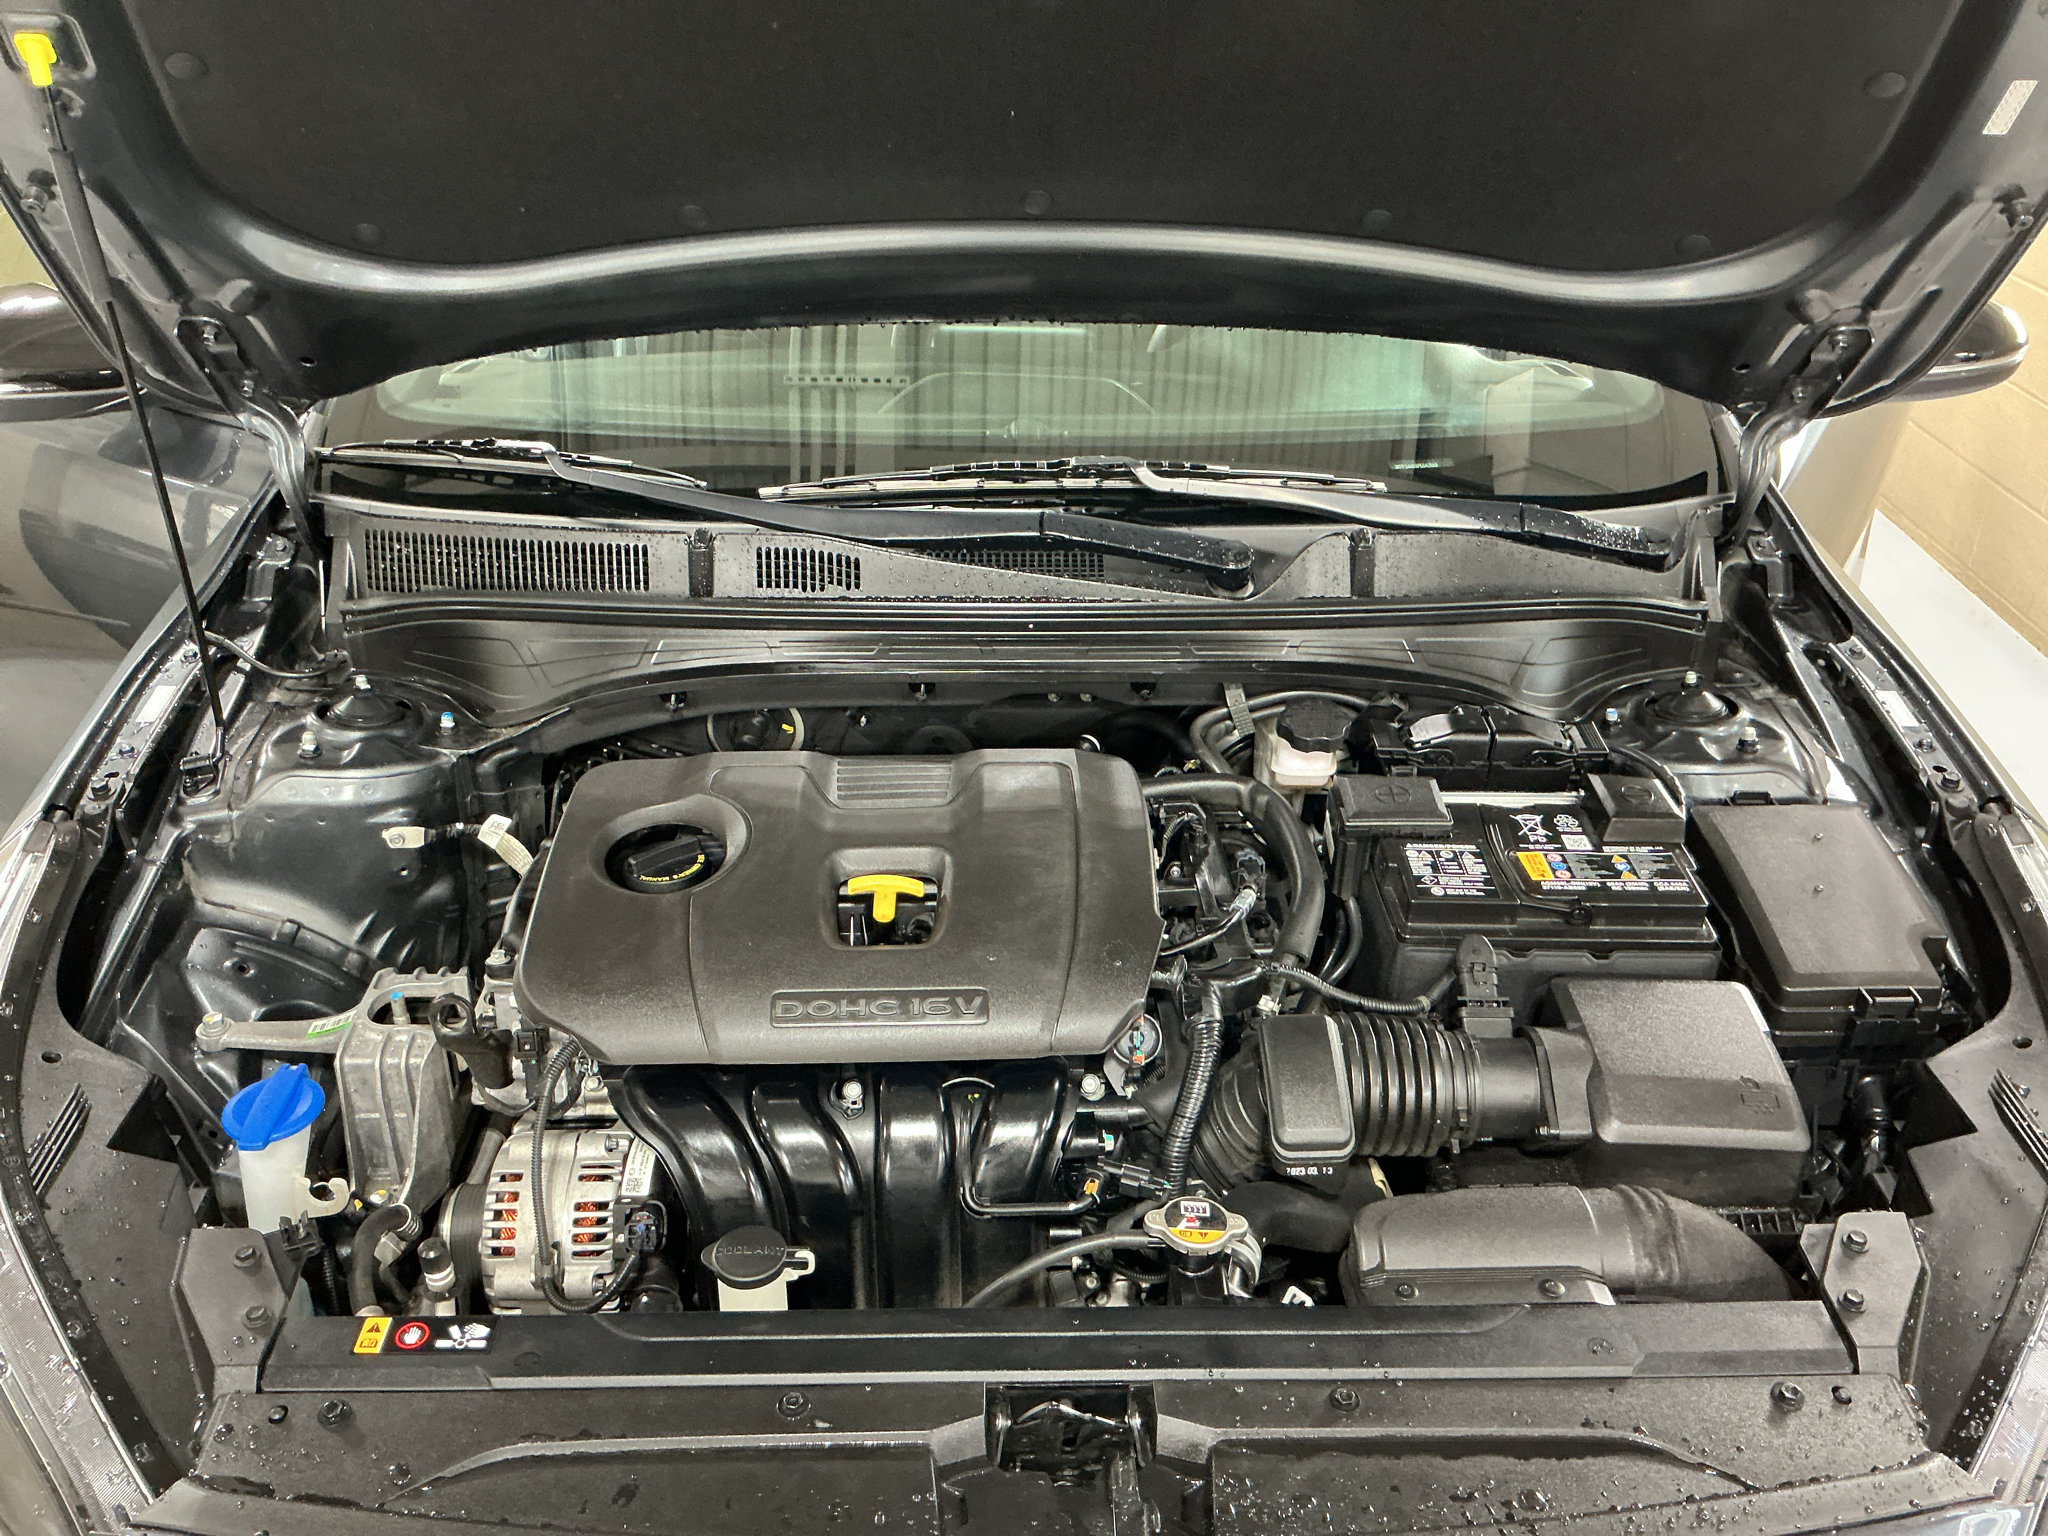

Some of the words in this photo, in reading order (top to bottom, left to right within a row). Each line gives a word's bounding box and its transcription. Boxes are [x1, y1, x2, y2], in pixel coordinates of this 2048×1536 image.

[1529, 834, 1547, 843] Pb
[774, 999, 898, 1018] DOHC
[911, 996, 984, 1016] 16V
[715, 1245, 785, 1256] COOLANT
